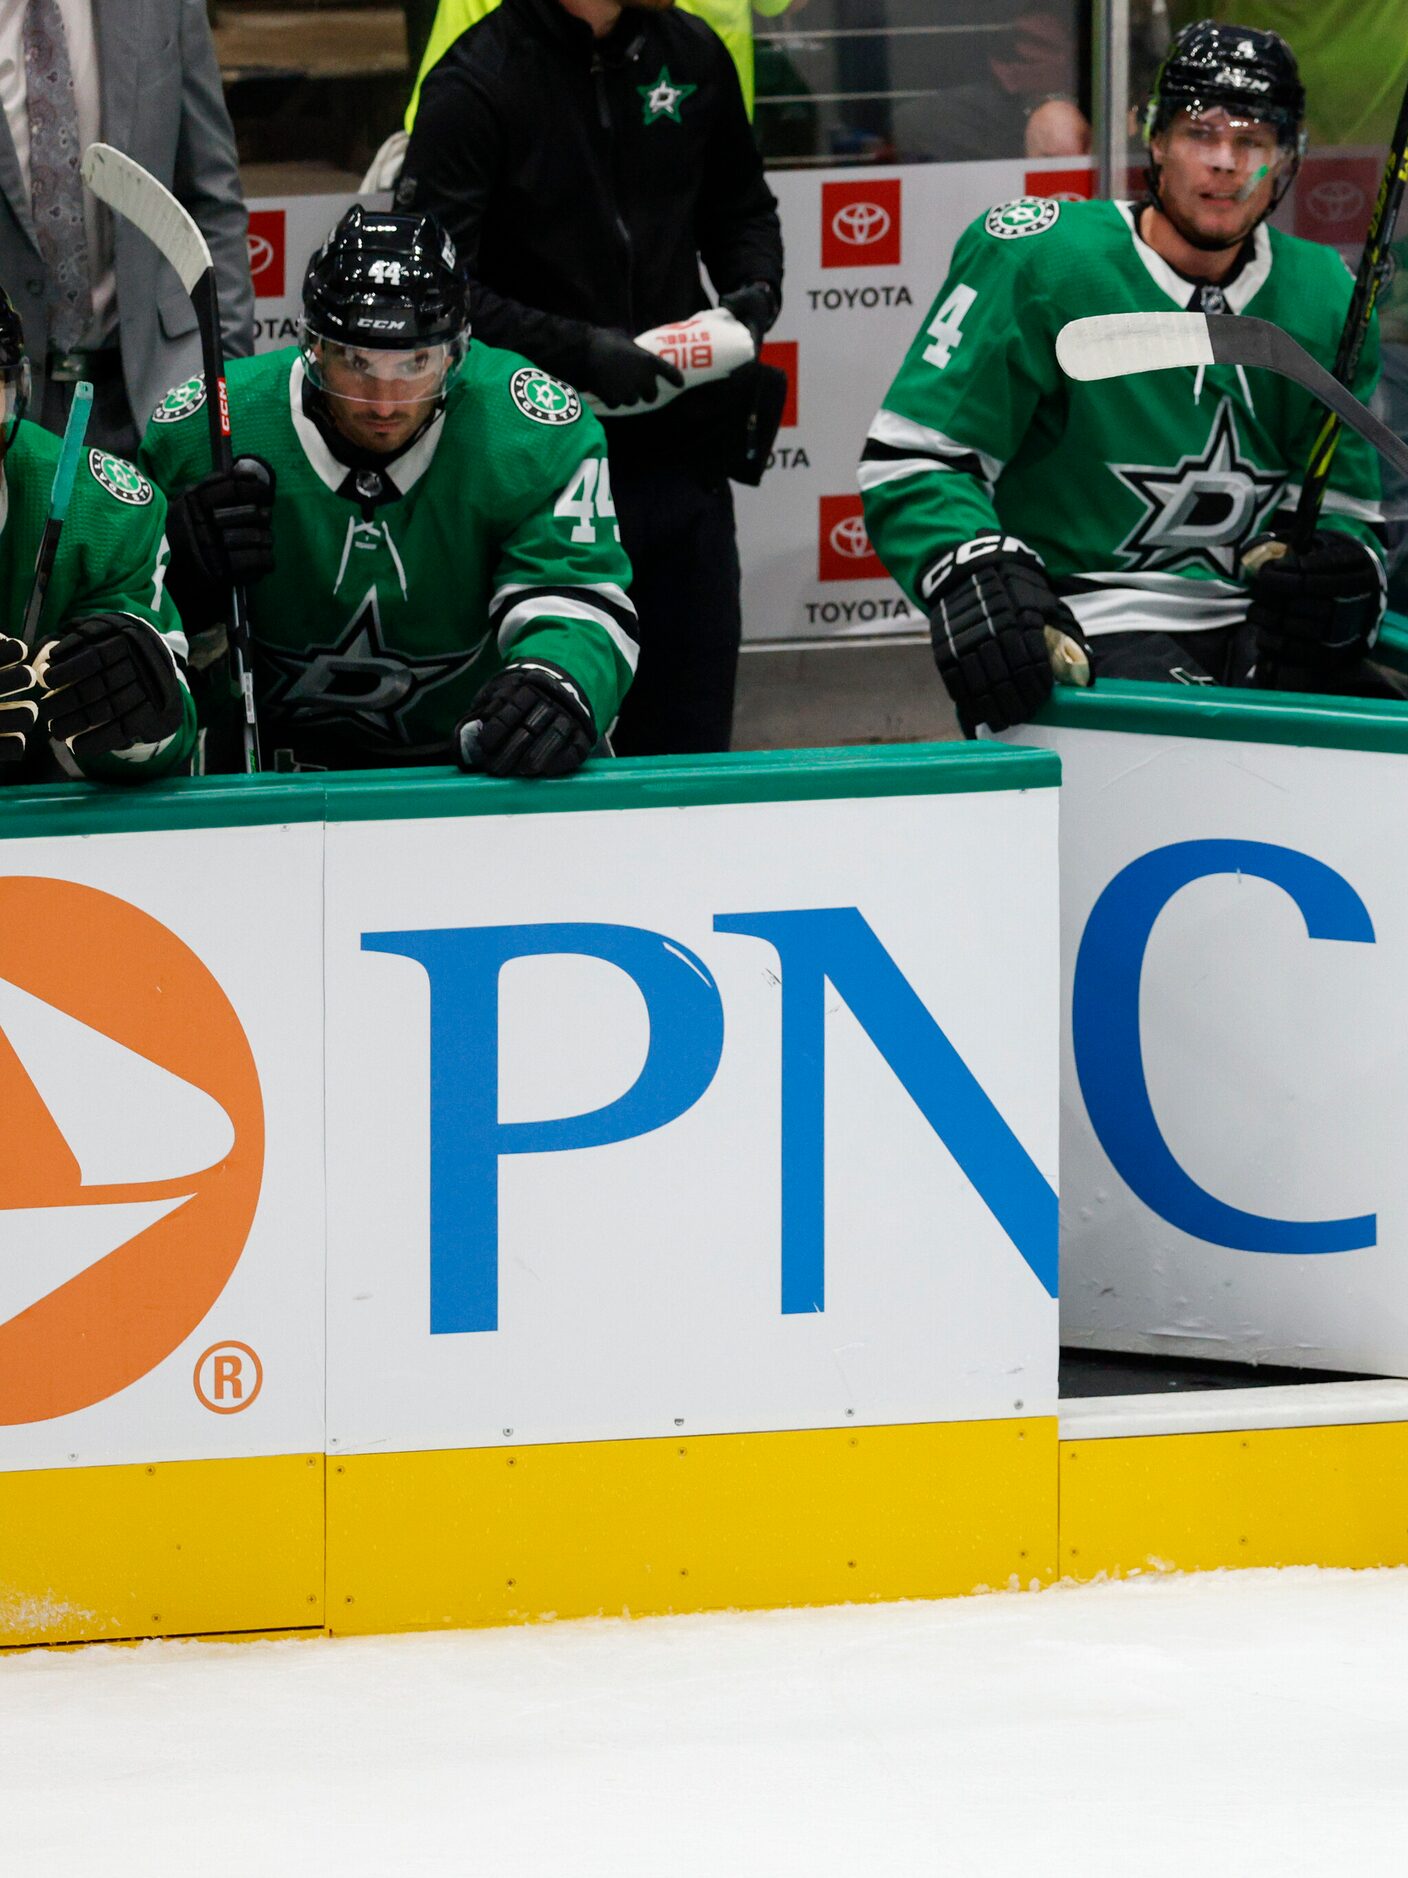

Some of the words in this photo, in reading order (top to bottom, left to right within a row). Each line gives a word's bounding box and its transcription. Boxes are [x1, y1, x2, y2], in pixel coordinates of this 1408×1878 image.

[367, 260, 401, 286] 44
[807, 286, 912, 311] TOYOTA
[356, 318, 406, 331] CCM
[922, 283, 978, 369] 4
[218, 380, 230, 432] CCM
[806, 598, 912, 624] TOYOTA
[361, 838, 1377, 1335] PNC
